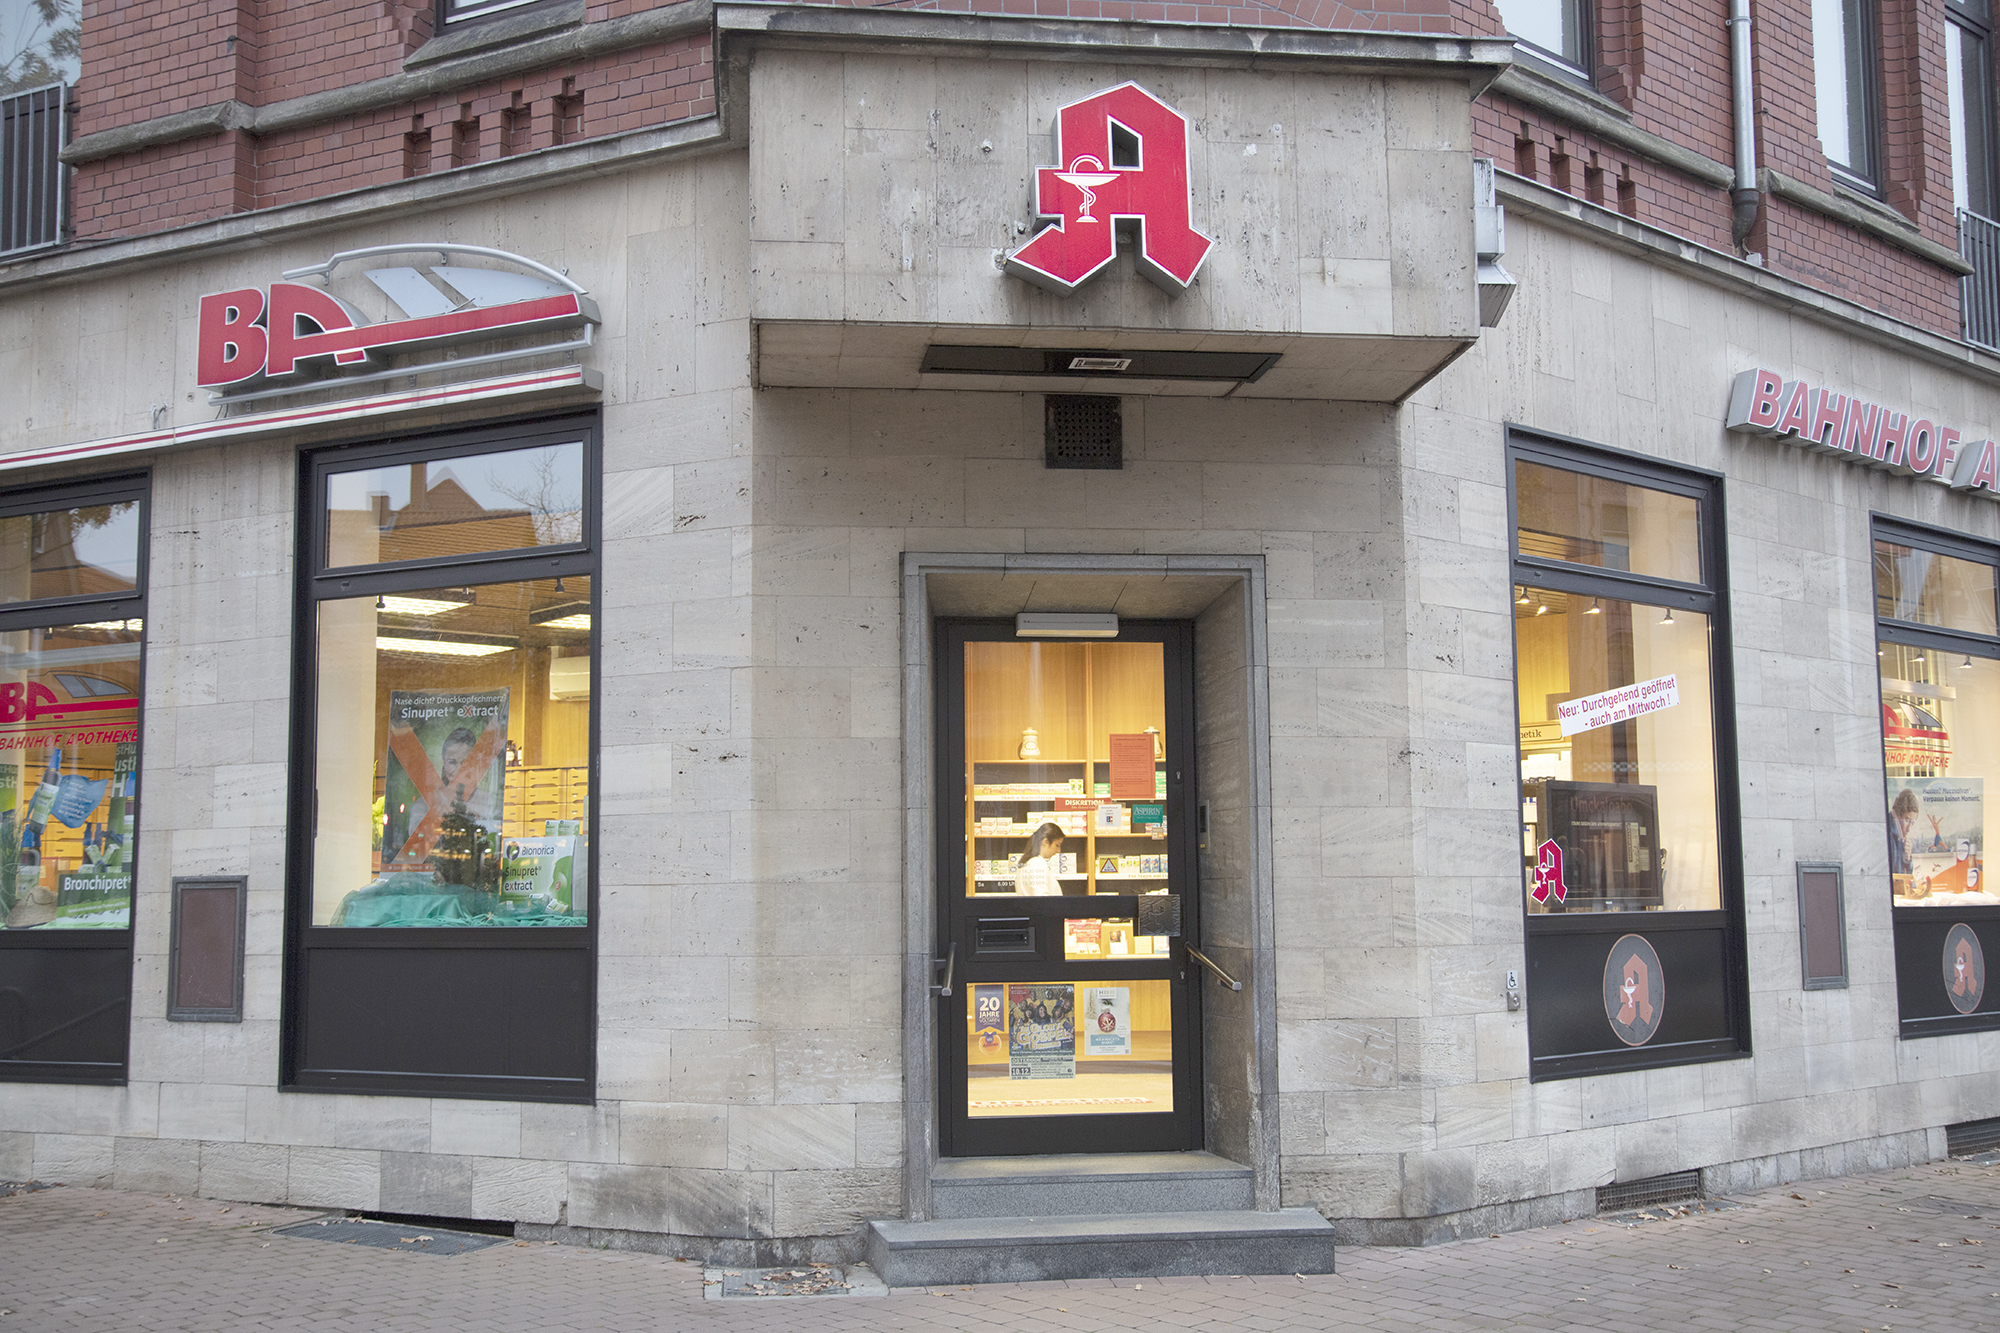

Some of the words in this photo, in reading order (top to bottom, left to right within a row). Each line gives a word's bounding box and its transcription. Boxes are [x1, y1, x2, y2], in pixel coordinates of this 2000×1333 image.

[1747, 367, 1962, 478] BAHNHOF
[413, 696, 436, 705] dicht?
[1558, 704, 1580, 719] Neu:
[1581, 686, 1640, 713] Durchgehend
[1641, 677, 1676, 699] geöffnet
[1590, 711, 1612, 728] auch
[1613, 708, 1627, 721] am
[1628, 695, 1666, 717] Mittwoch
[0, 734, 62, 751] BAHNHOF
[65, 729, 137, 746] APOTHEKE
[1908, 754, 1950, 768] APOTHEKE
[1134, 806, 1161, 815] ASPIRIN
[521, 846, 555, 856] Bionorica
[504, 880, 533, 891] extract
[979, 996, 1000, 1011] 20
[979, 1011, 1000, 1019] JAHRE
[1016, 1028, 1071, 1046] GOSPEL
